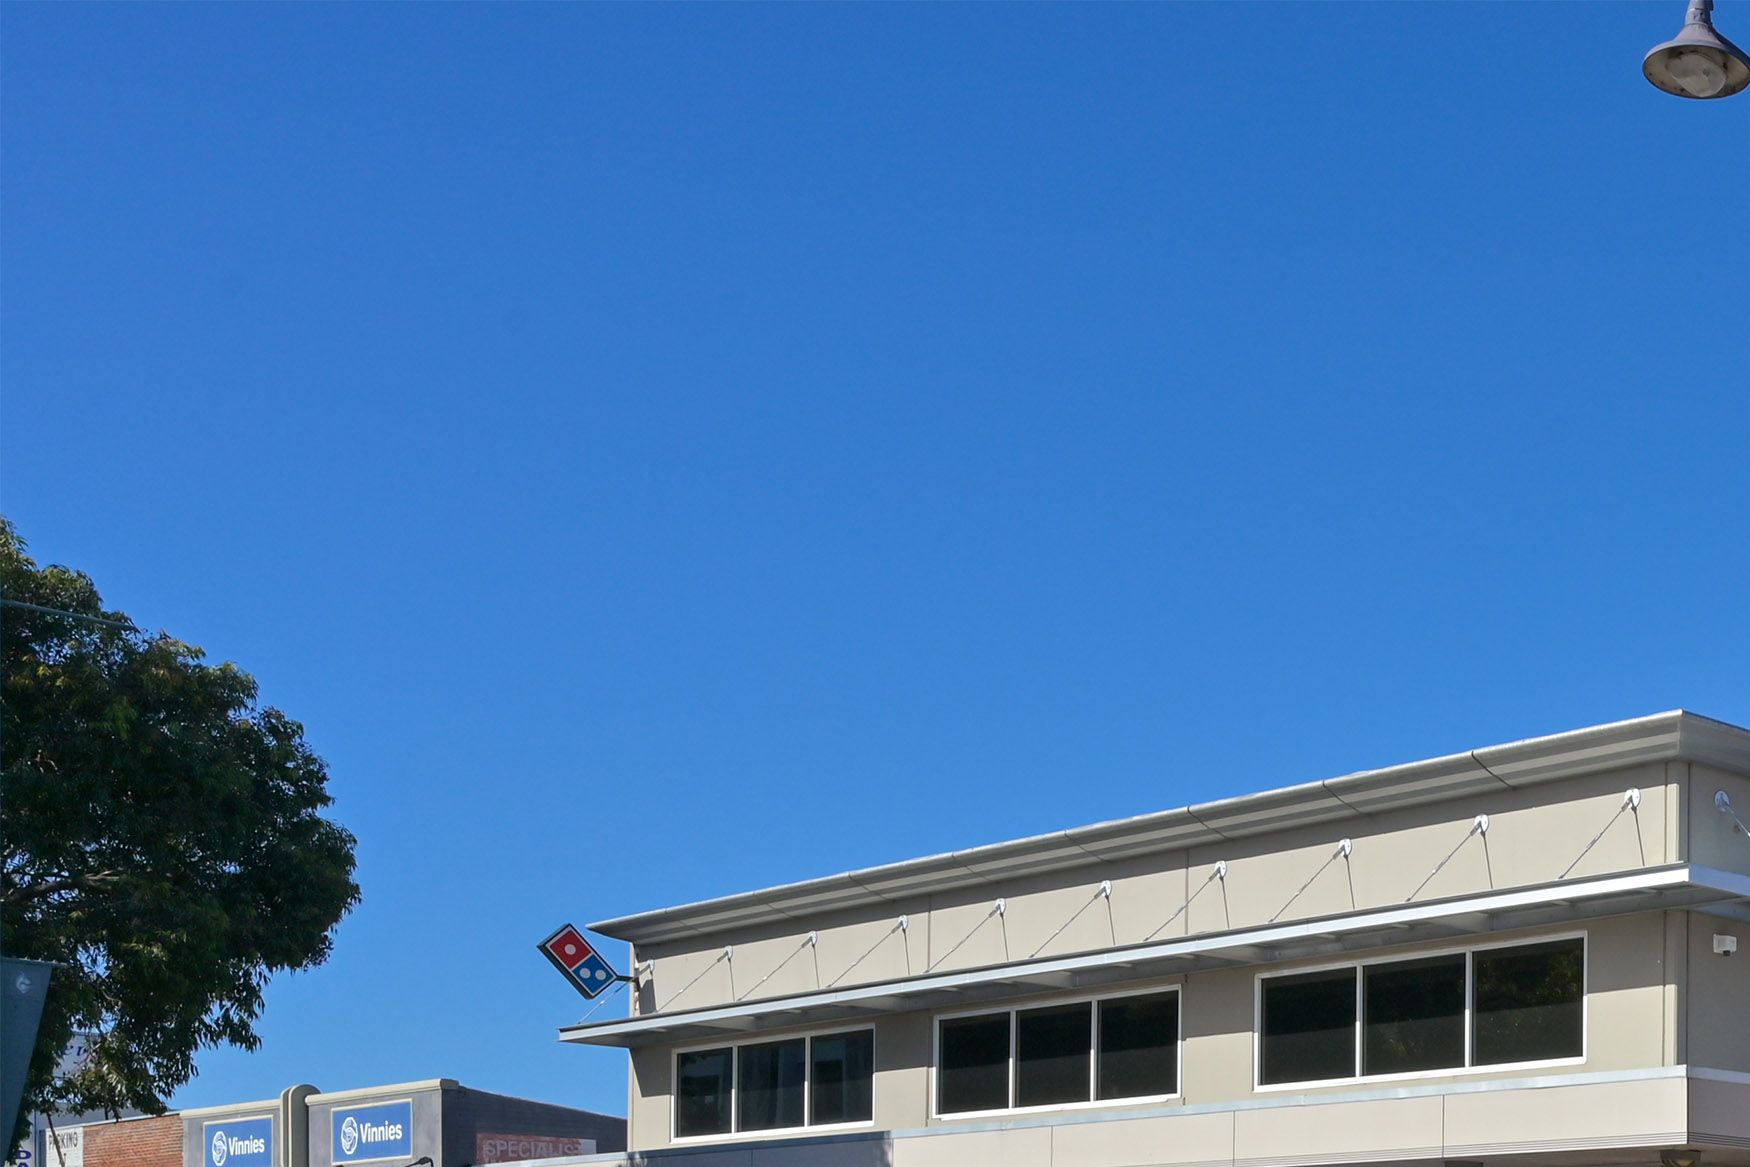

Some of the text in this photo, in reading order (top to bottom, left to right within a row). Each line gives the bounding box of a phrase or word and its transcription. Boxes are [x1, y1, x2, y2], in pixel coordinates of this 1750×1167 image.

[48, 1131, 79, 1151] PKING
[359, 1120, 402, 1144] Vinnies
[228, 1135, 265, 1156] Vinnies
